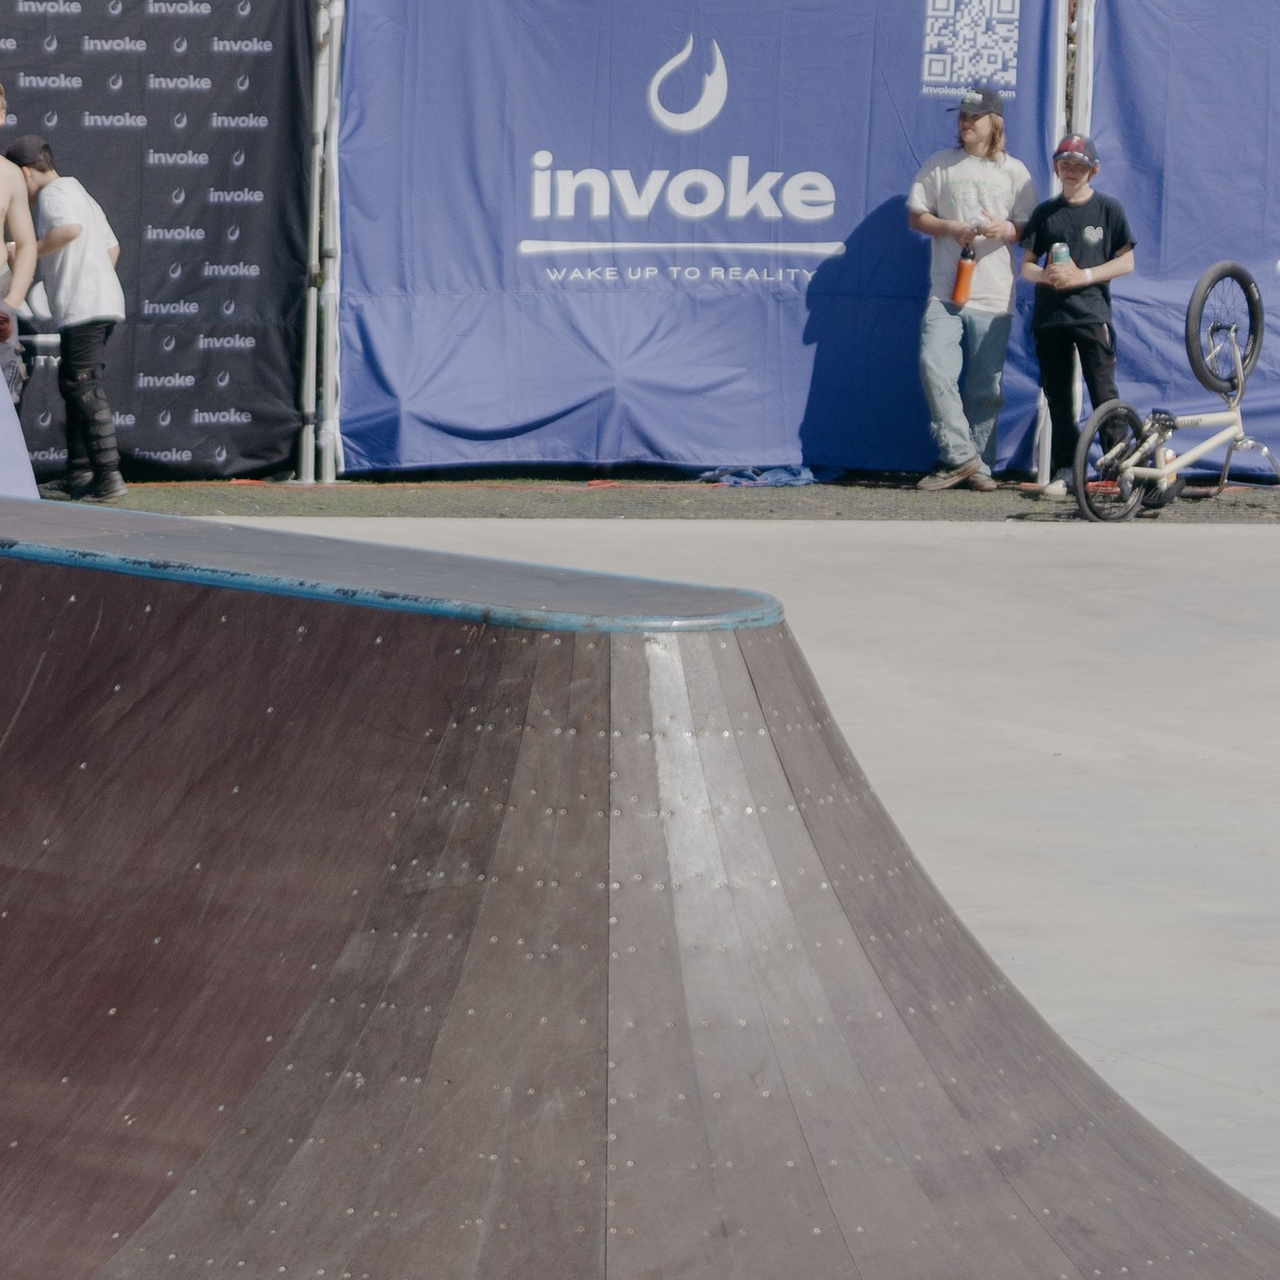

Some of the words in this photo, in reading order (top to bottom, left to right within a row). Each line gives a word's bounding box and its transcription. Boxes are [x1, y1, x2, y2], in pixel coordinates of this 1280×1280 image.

[148, 0, 211, 14] invoke
[84, 36, 146, 51] invoke
[213, 37, 272, 51] invoke
[19, 73, 82, 88] invoke
[149, 74, 211, 89] invoke
[84, 112, 147, 126] invoke
[212, 113, 268, 127] invoke
[149, 149, 208, 164] invoke
[532, 151, 835, 220] invoke
[209, 188, 263, 202] invoke
[147, 225, 204, 240] invoke
[204, 262, 259, 276] invoke
[546, 267, 618, 280] WAKE
[628, 267, 658, 280] UP
[669, 266, 701, 280] TO
[710, 267, 817, 282] REALITY
[144, 300, 198, 314] invoke
[198, 334, 255, 349] invoke
[139, 373, 195, 387] invoke
[194, 408, 251, 423] invoke
